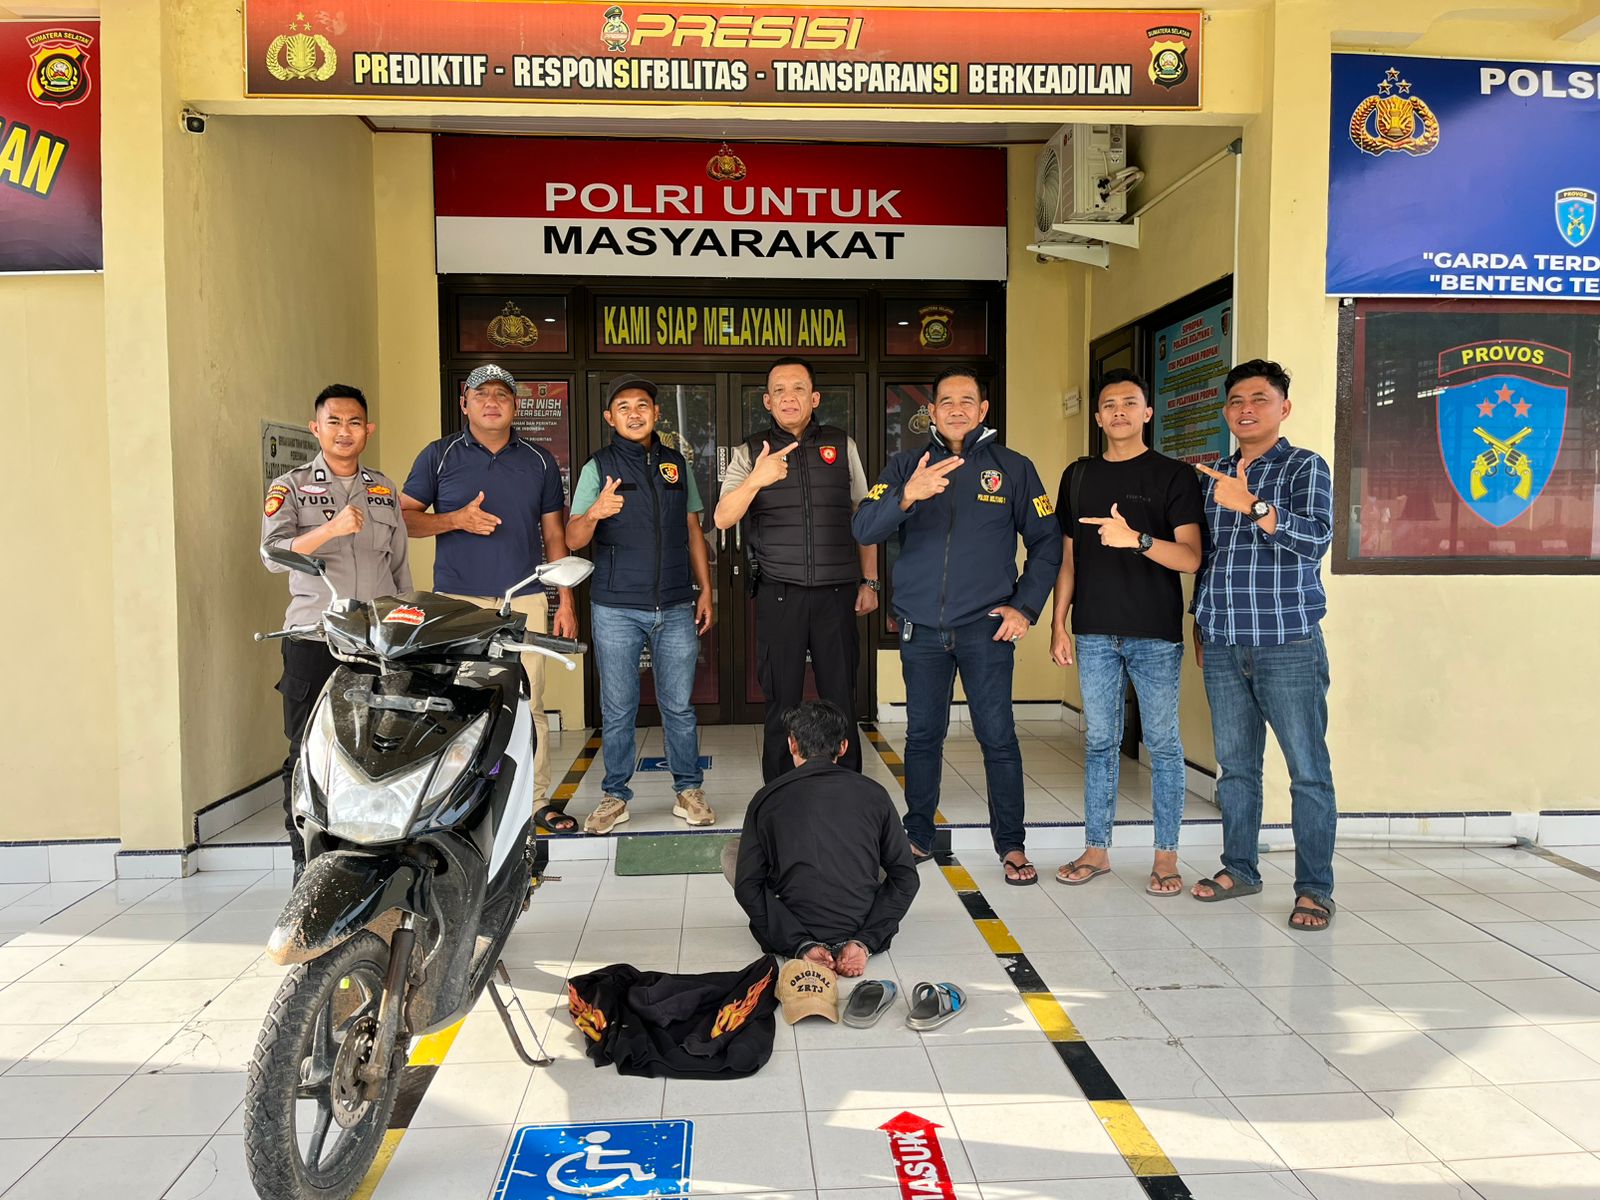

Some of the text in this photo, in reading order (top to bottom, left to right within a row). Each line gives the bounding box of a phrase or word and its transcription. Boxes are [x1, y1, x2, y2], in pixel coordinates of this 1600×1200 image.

[30, 32, 90, 44] SUMATERA SELATAN
[631, 14, 863, 50] PRESISI
[353, 53, 487, 86] PREDIKTIF
[512, 56, 748, 91] RESPONSIFBILITAS
[773, 61, 958, 94] TRANSPARANSI
[968, 65, 1131, 95] BERKEADILAN
[0, 122, 66, 195] AN
[545, 182, 902, 218] POLRI UNTUK
[543, 225, 905, 260] MASYARAKAT
[1423, 252, 1528, 270] "GARDA
[1430, 274, 1563, 292] "BENTENG
[604, 305, 847, 347] KAMI SIAP MELAYANI ANDA
[1461, 345, 1545, 365] PROVOS
[518, 399, 562, 409] ER WISH
[298, 496, 335, 506] YUDI
[790, 970, 831, 988] ORIGINAL
